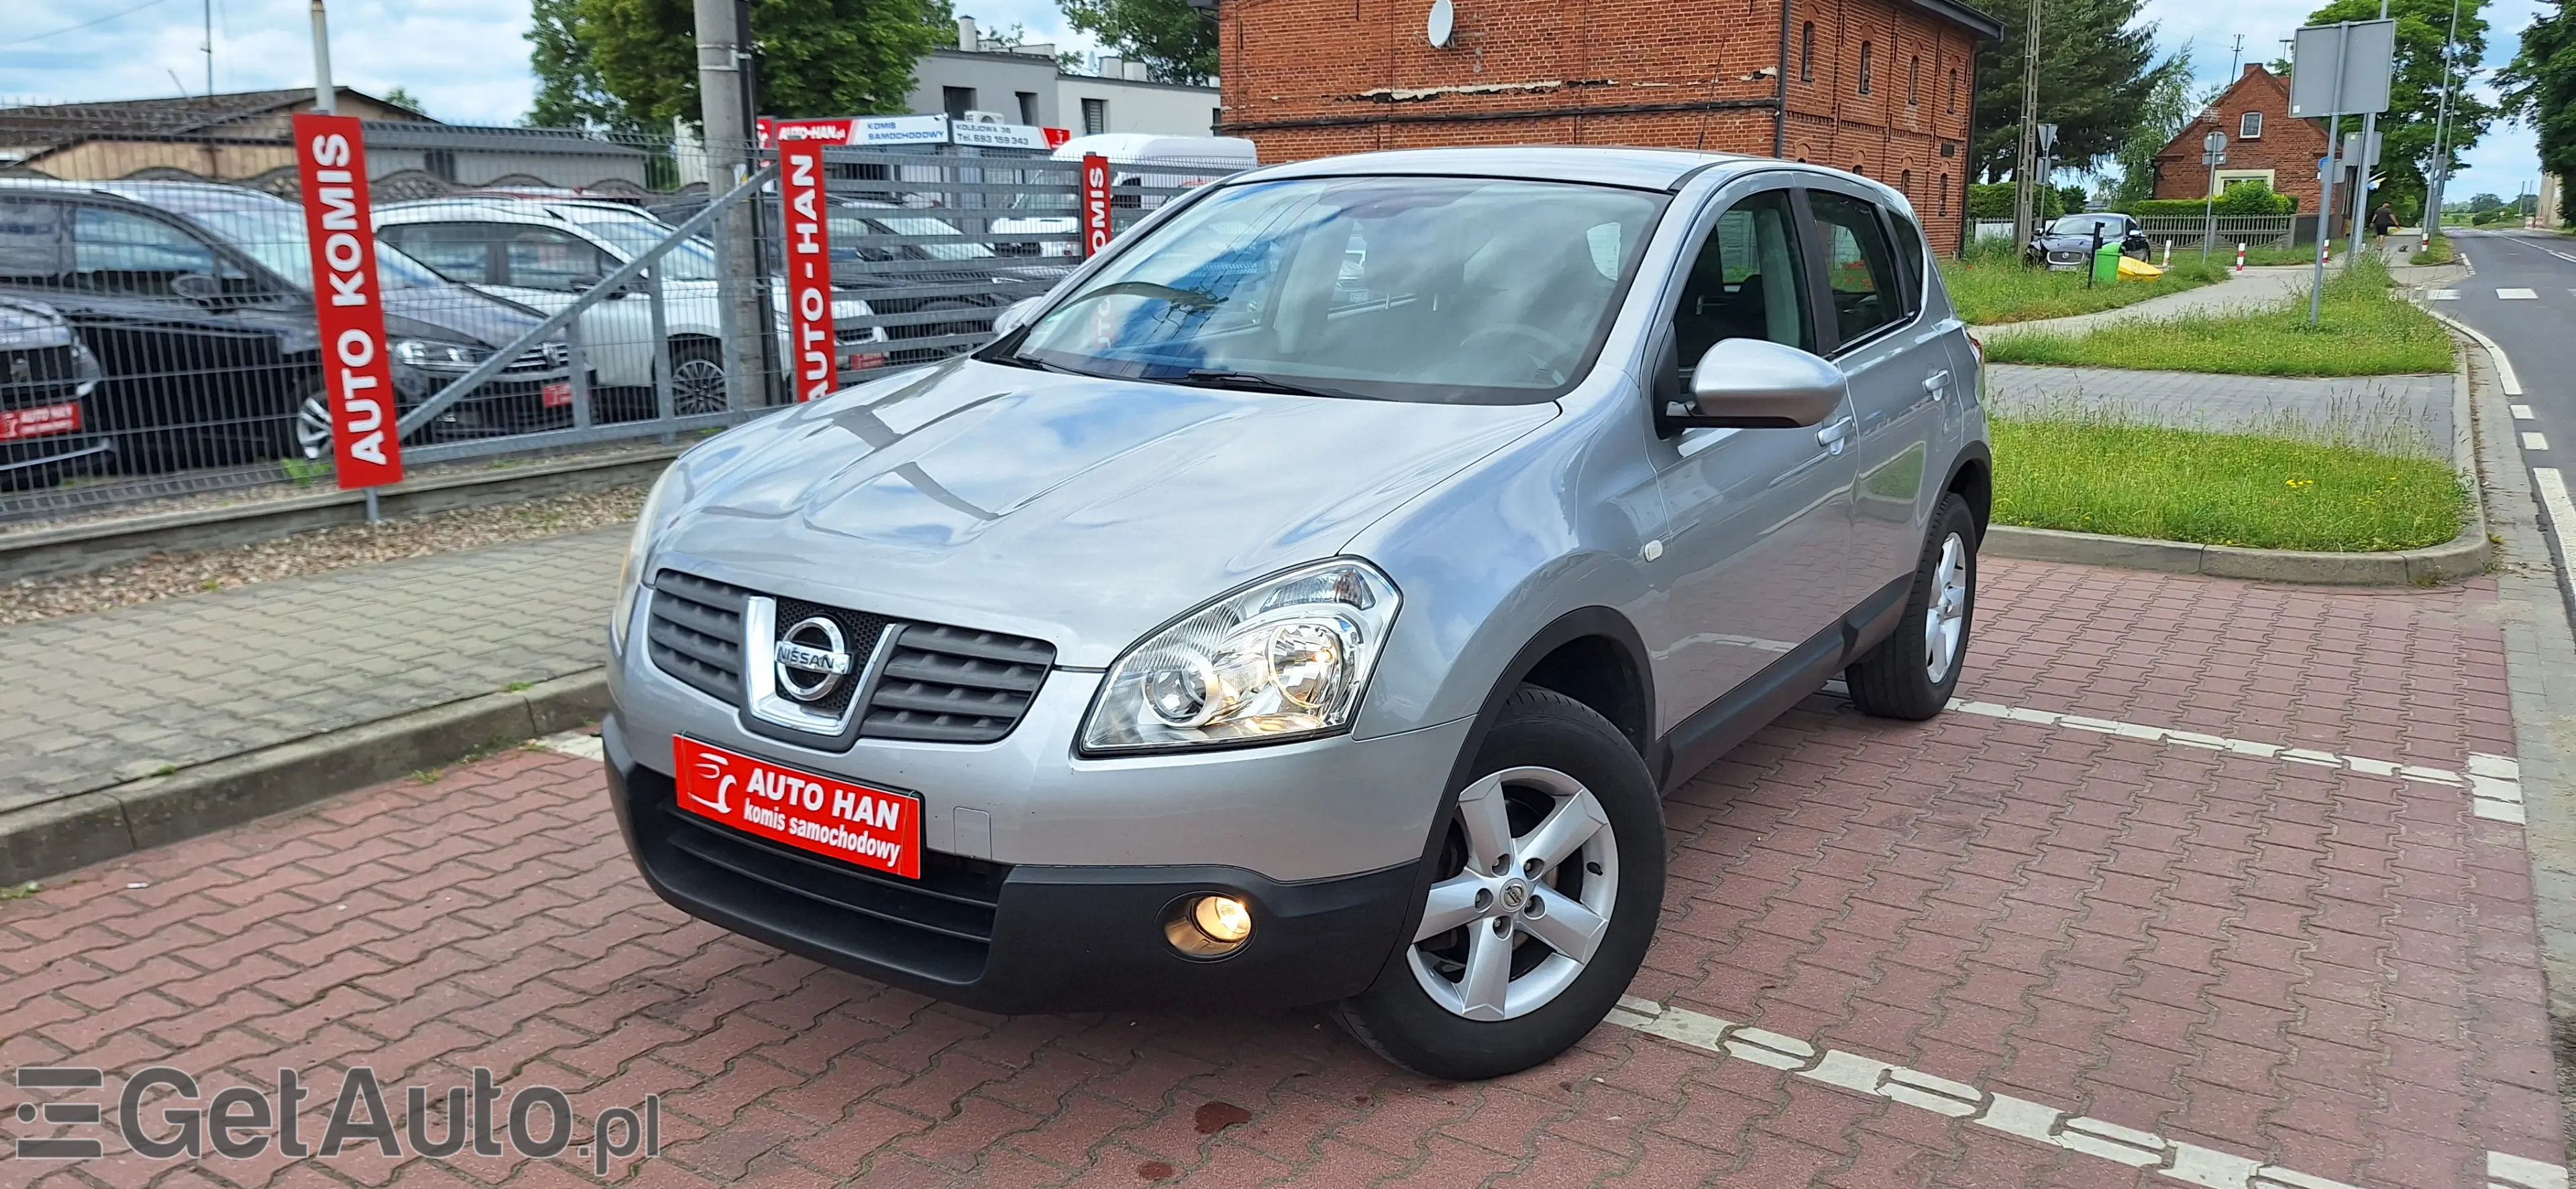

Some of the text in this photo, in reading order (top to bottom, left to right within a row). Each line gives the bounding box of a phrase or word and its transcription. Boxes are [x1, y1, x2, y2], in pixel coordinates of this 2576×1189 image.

[868, 131, 945, 140] SAMOCHODOWY
[956, 123, 998, 132] KOLEJOWA
[1089, 167, 1106, 253] OMIS
[313, 133, 387, 465] AUTO KOMIS
[777, 645, 835, 669] NISSAN
[743, 797, 902, 867] komis samochodowy
[746, 767, 900, 832] AUTO HAN
